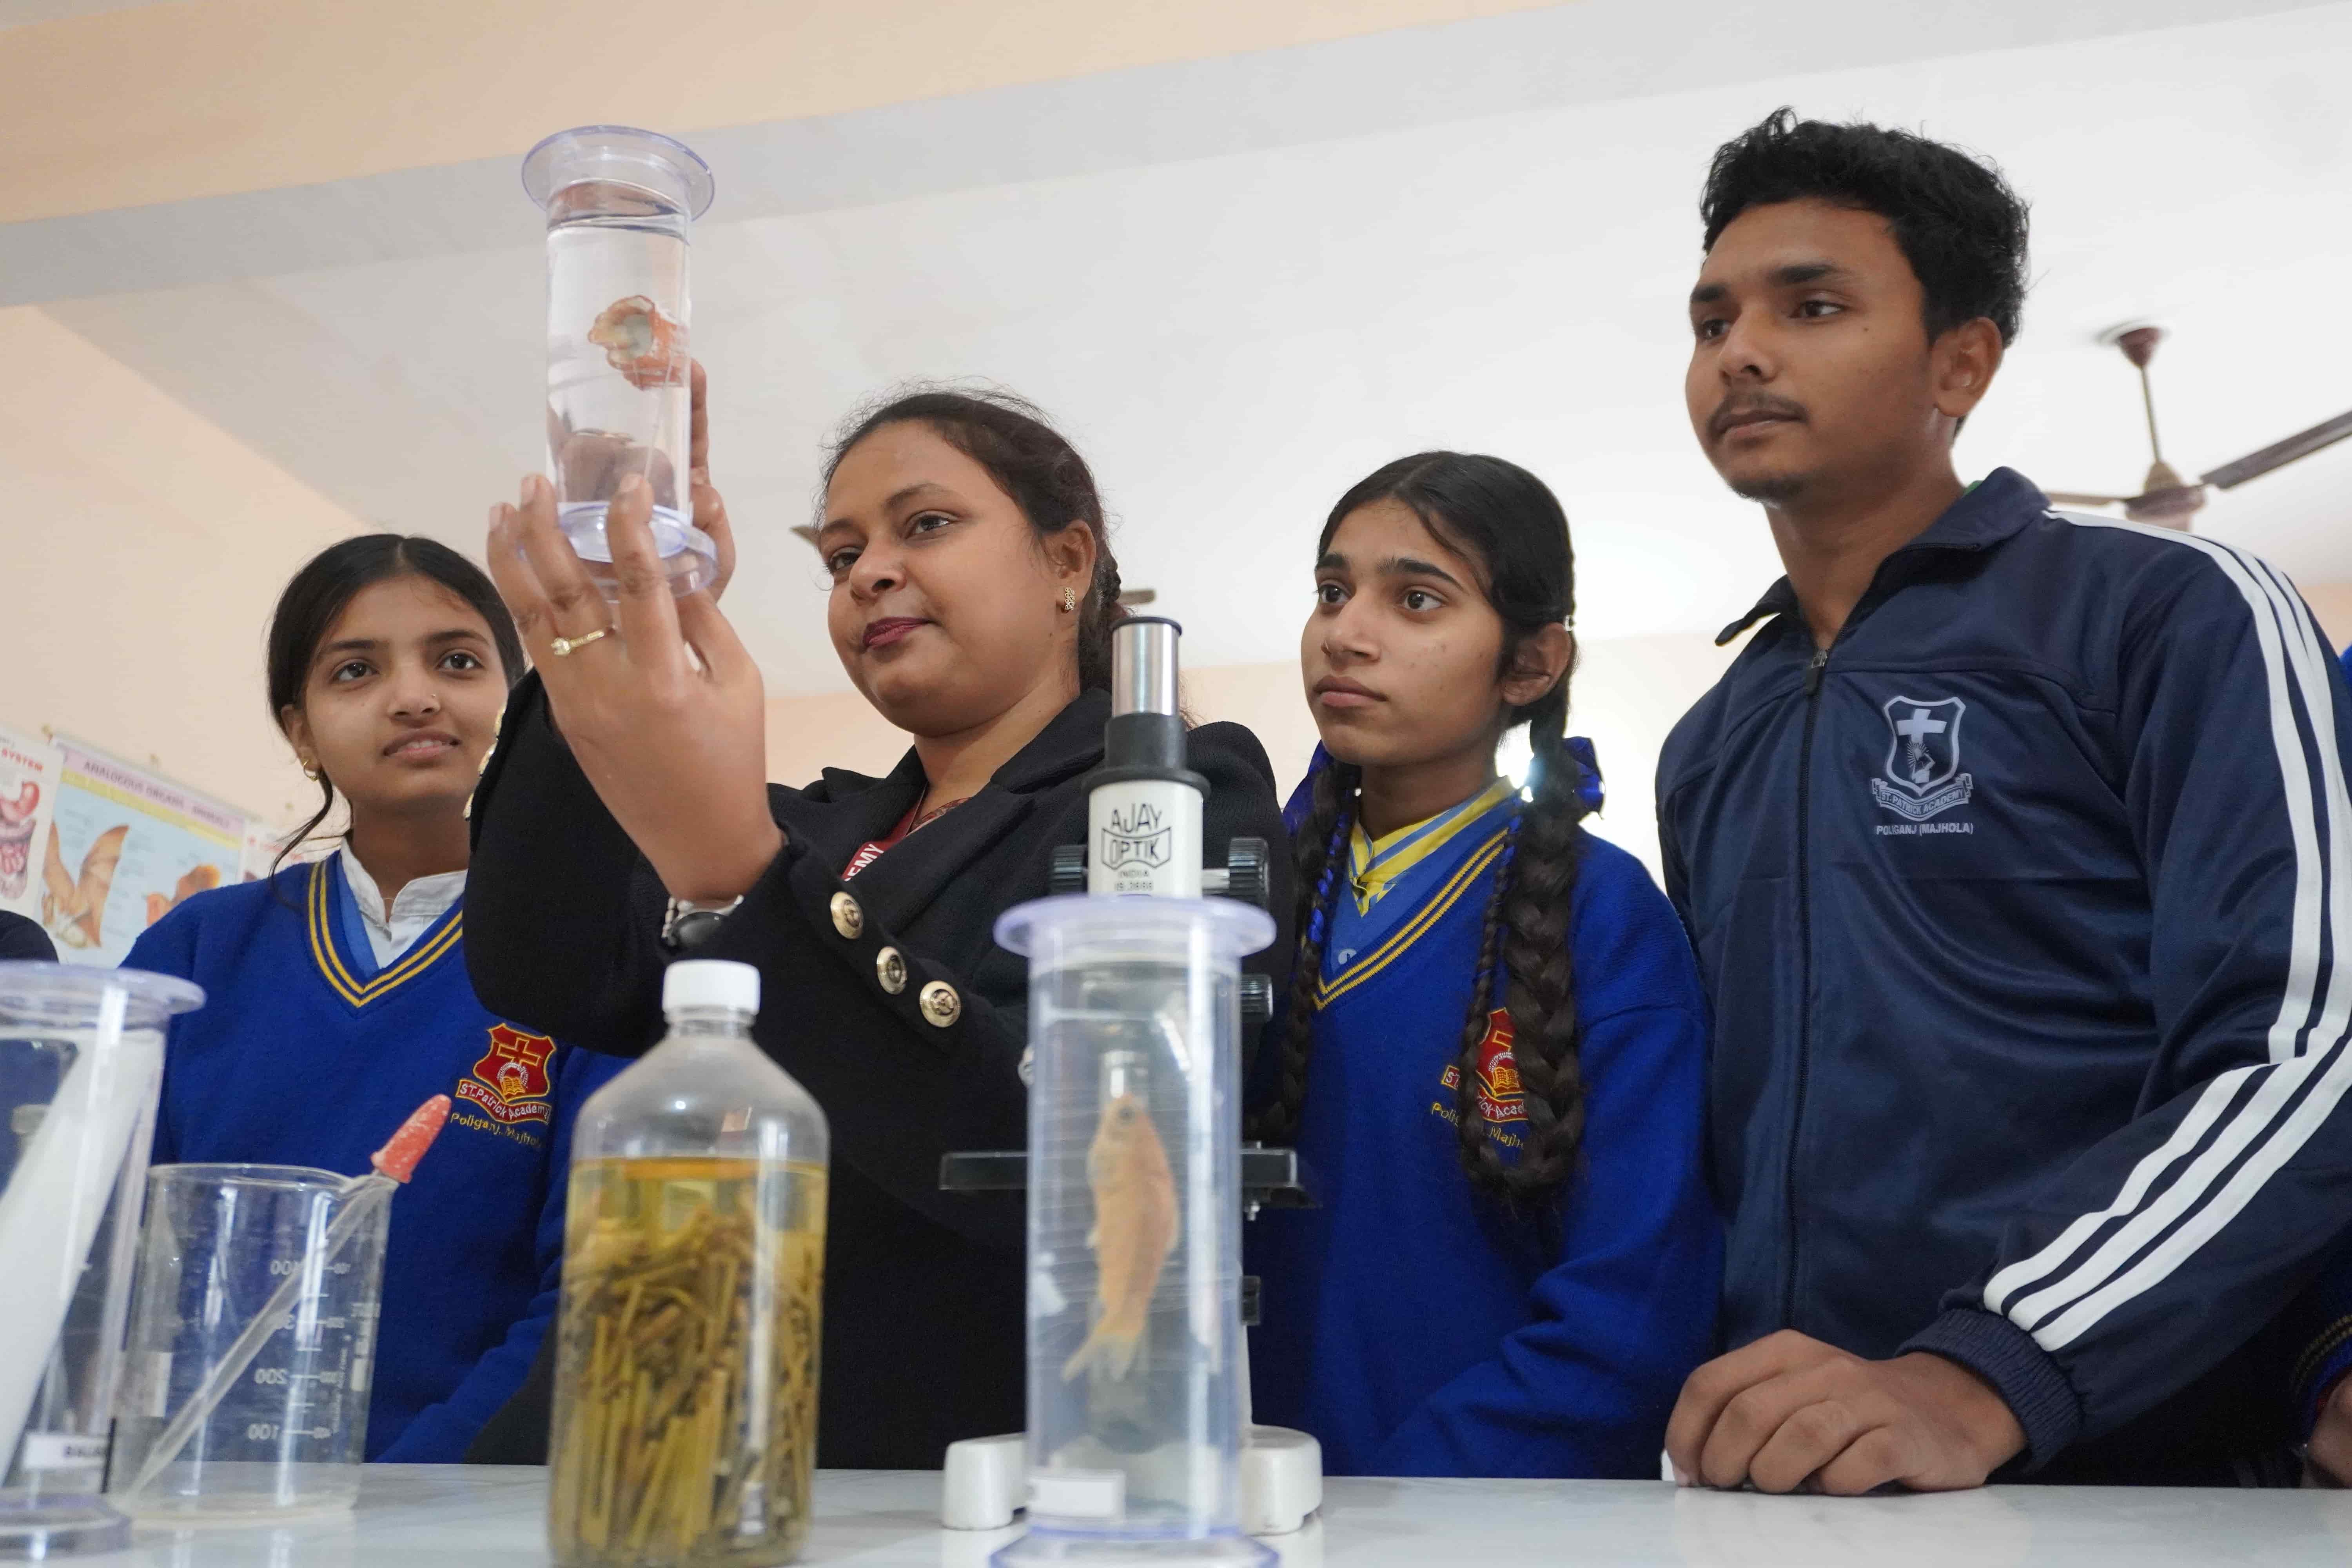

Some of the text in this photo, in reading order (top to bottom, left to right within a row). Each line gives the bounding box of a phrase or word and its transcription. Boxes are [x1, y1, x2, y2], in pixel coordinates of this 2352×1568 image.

[2, 747, 44, 772] SYSTEM
[1892, 794, 1922, 814] PATRICK
[1922, 789, 1964, 814] ACADEMY
[1111, 803, 1162, 833] AJAY
[1876, 823, 1974, 837] POLIGANJ (MAJHOLA)
[1109, 837, 1160, 864] OPTIK
[1495, 1100, 1524, 1120] Acad
